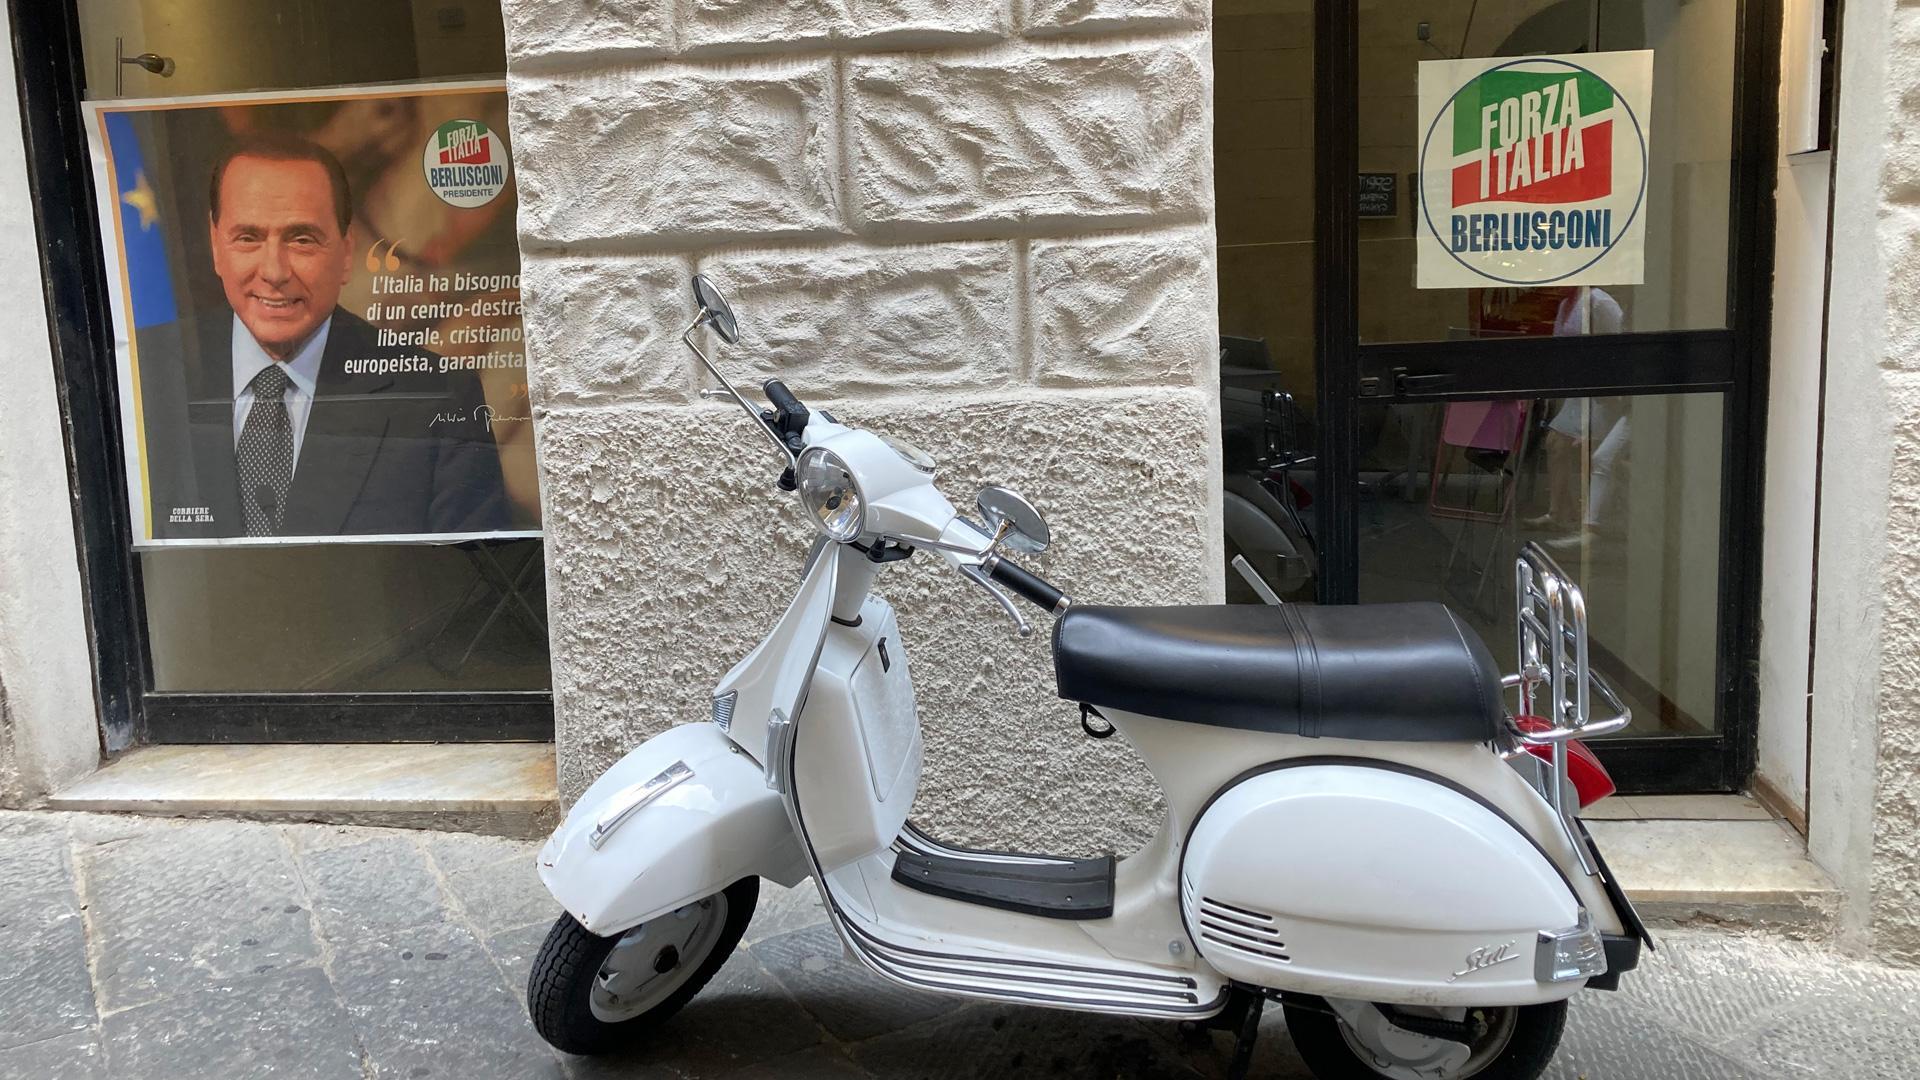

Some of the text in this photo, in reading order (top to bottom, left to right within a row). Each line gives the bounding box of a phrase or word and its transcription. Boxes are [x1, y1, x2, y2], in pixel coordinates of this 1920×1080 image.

[1479, 78, 1581, 149] FORZA
[447, 124, 478, 147] FORZA
[447, 139, 481, 162] ITALIA
[1480, 124, 1585, 200] ITALIA
[431, 165, 503, 187] BERLUSCONI
[443, 188, 494, 198] PRESIDENTE
[1451, 209, 1612, 252] BERLUSCONI
[372, 272, 520, 294] L'Italia ha bisogno
[366, 299, 522, 321] di un centro-destra
[377, 327, 443, 347] liberale,
[344, 354, 433, 375] europeista,
[169, 514, 215, 522] DELLA SERA
[172, 507, 210, 515] CORRIERE
